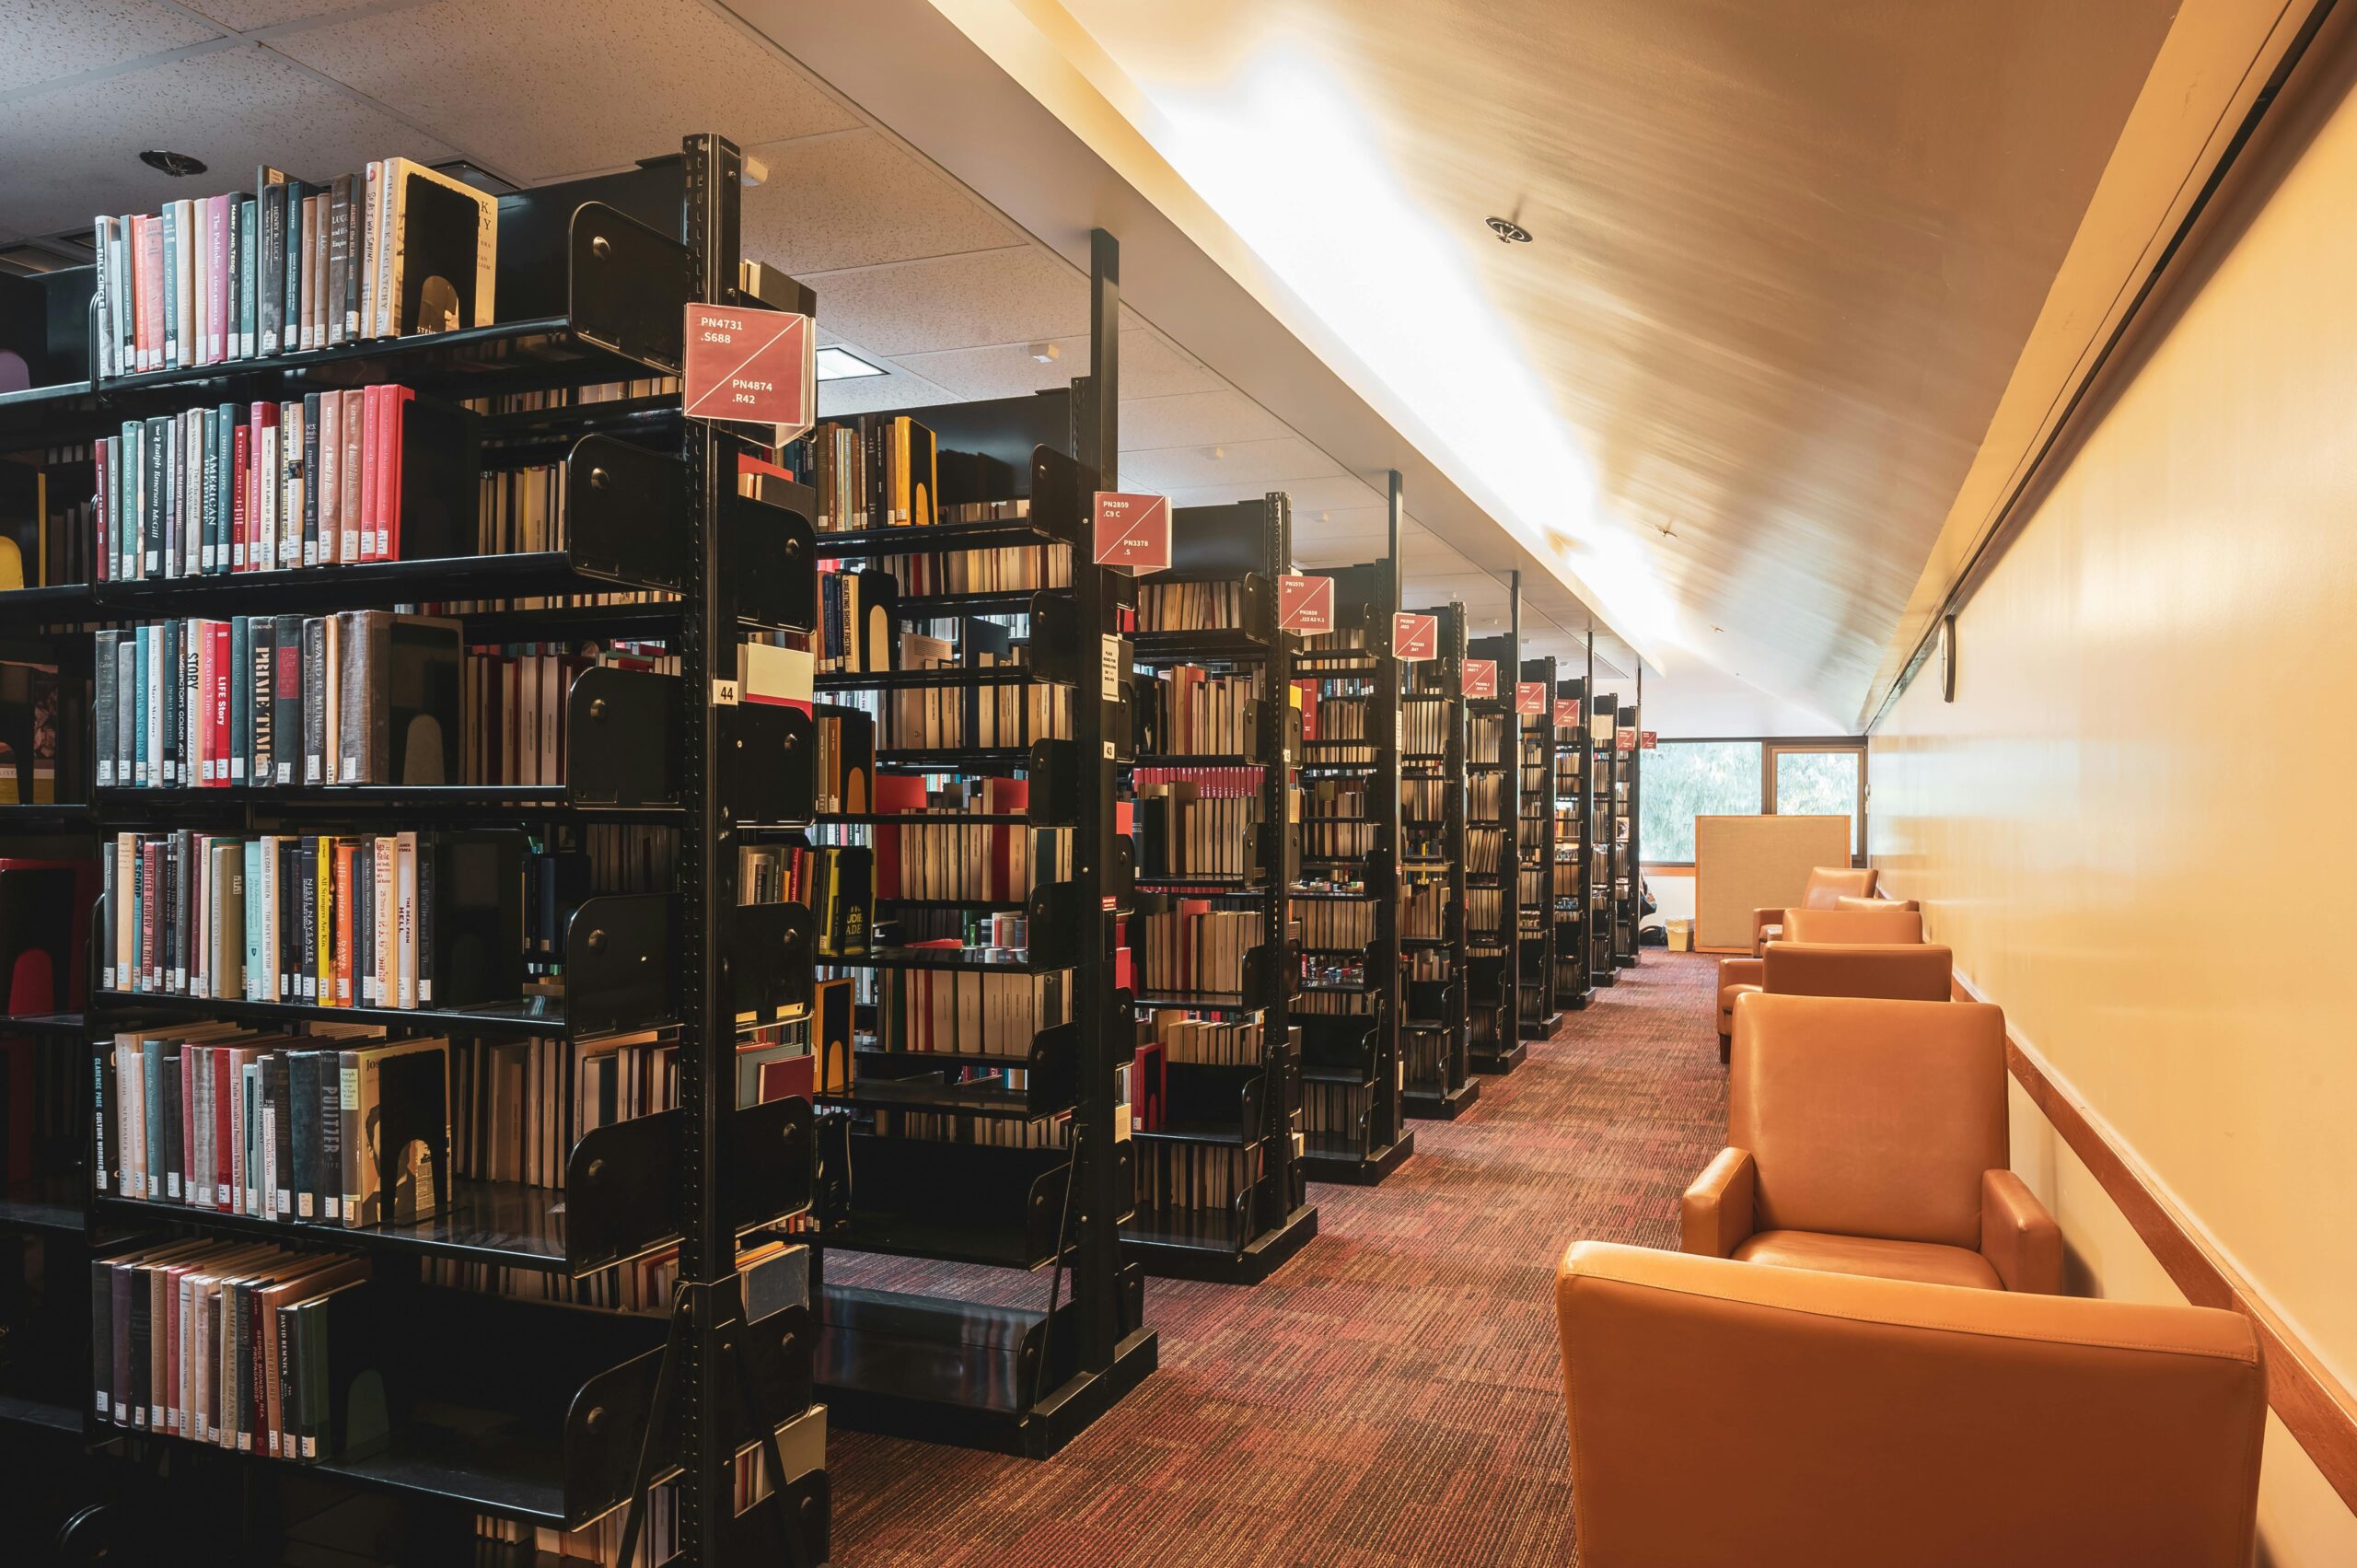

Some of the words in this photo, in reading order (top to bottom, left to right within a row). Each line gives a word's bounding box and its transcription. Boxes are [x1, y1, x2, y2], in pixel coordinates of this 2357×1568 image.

[384, 175, 393, 227] CHARLES
[481, 201, 493, 215] K.
[213, 213, 221, 230] The
[96, 224, 104, 248] COMING
[380, 243, 389, 309] McCLATCHY
[701, 317, 743, 331] PN4731
[701, 332, 731, 344] .S688
[732, 379, 773, 392] PN4874
[732, 393, 756, 404] .R42
[153, 443, 162, 469] Ralph
[324, 452, 332, 472] World
[348, 450, 356, 470] World
[152, 470, 160, 507] Emerson
[208, 454, 217, 526] AMERICAN
[324, 472, 332, 482] in
[125, 494, 132, 505] OF
[151, 508, 159, 539] McGill
[313, 624, 323, 677] EDWARD
[187, 652, 199, 690] STORY
[204, 656, 213, 690] Against
[255, 646, 270, 708] PRIME
[218, 676, 226, 698] LIFE
[720, 686, 734, 701] 44
[216, 701, 226, 726] Story
[314, 695, 324, 749] MURROW
[1107, 747, 1113, 757] 43
[145, 850, 153, 892] VOLUNTEER
[144, 895, 153, 928] SLAVERY
[319, 887, 328, 920] Strangers
[144, 931, 153, 947] JILL
[365, 927, 371, 936] Up
[144, 949, 153, 977] NELSON
[145, 1051, 154, 1063] Eye
[322, 1086, 339, 1153] PULITZER
[266, 1339, 274, 1361] HARRY
[280, 1340, 288, 1376] REMNICK
[228, 1349, 237, 1381] NEVER
[267, 1362, 276, 1401] REASONER
[228, 1385, 237, 1423] BLINKS
